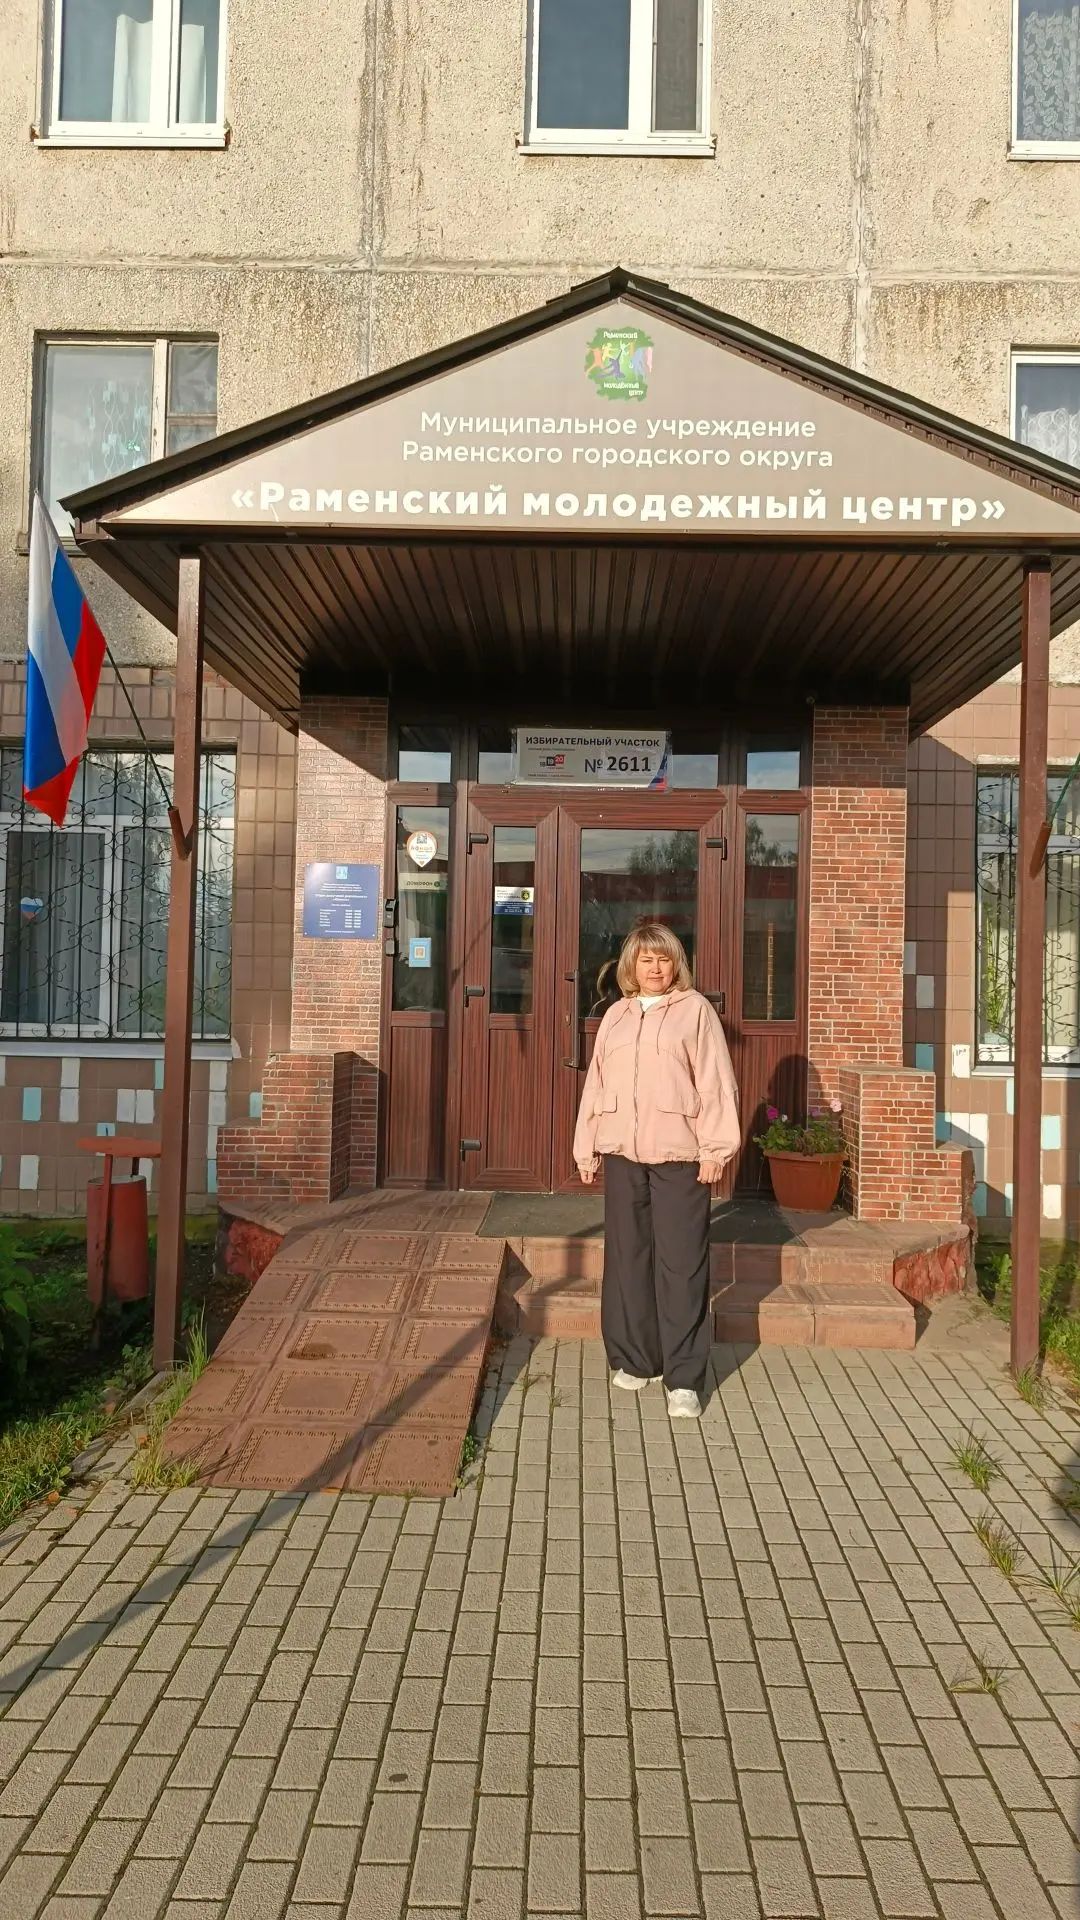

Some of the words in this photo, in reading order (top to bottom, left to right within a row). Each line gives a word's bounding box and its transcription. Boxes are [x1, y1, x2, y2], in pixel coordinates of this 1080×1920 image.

[420, 411, 638, 436] Муниципальное
[646, 418, 816, 440] учреждение
[402, 440, 563, 464] Раменского
[572, 446, 731, 468] городского
[739, 449, 833, 471] округа
[231, 480, 508, 516] «Раменский
[523, 488, 827, 522] молодежный
[842, 496, 1006, 527] центр»
[526, 736, 612, 746] ИЗБИРАТЕЛЬНЫЙ
[615, 738, 660, 747] УЧАСТОК
[584, 758, 603, 773] №
[606, 756, 652, 772] 2611
